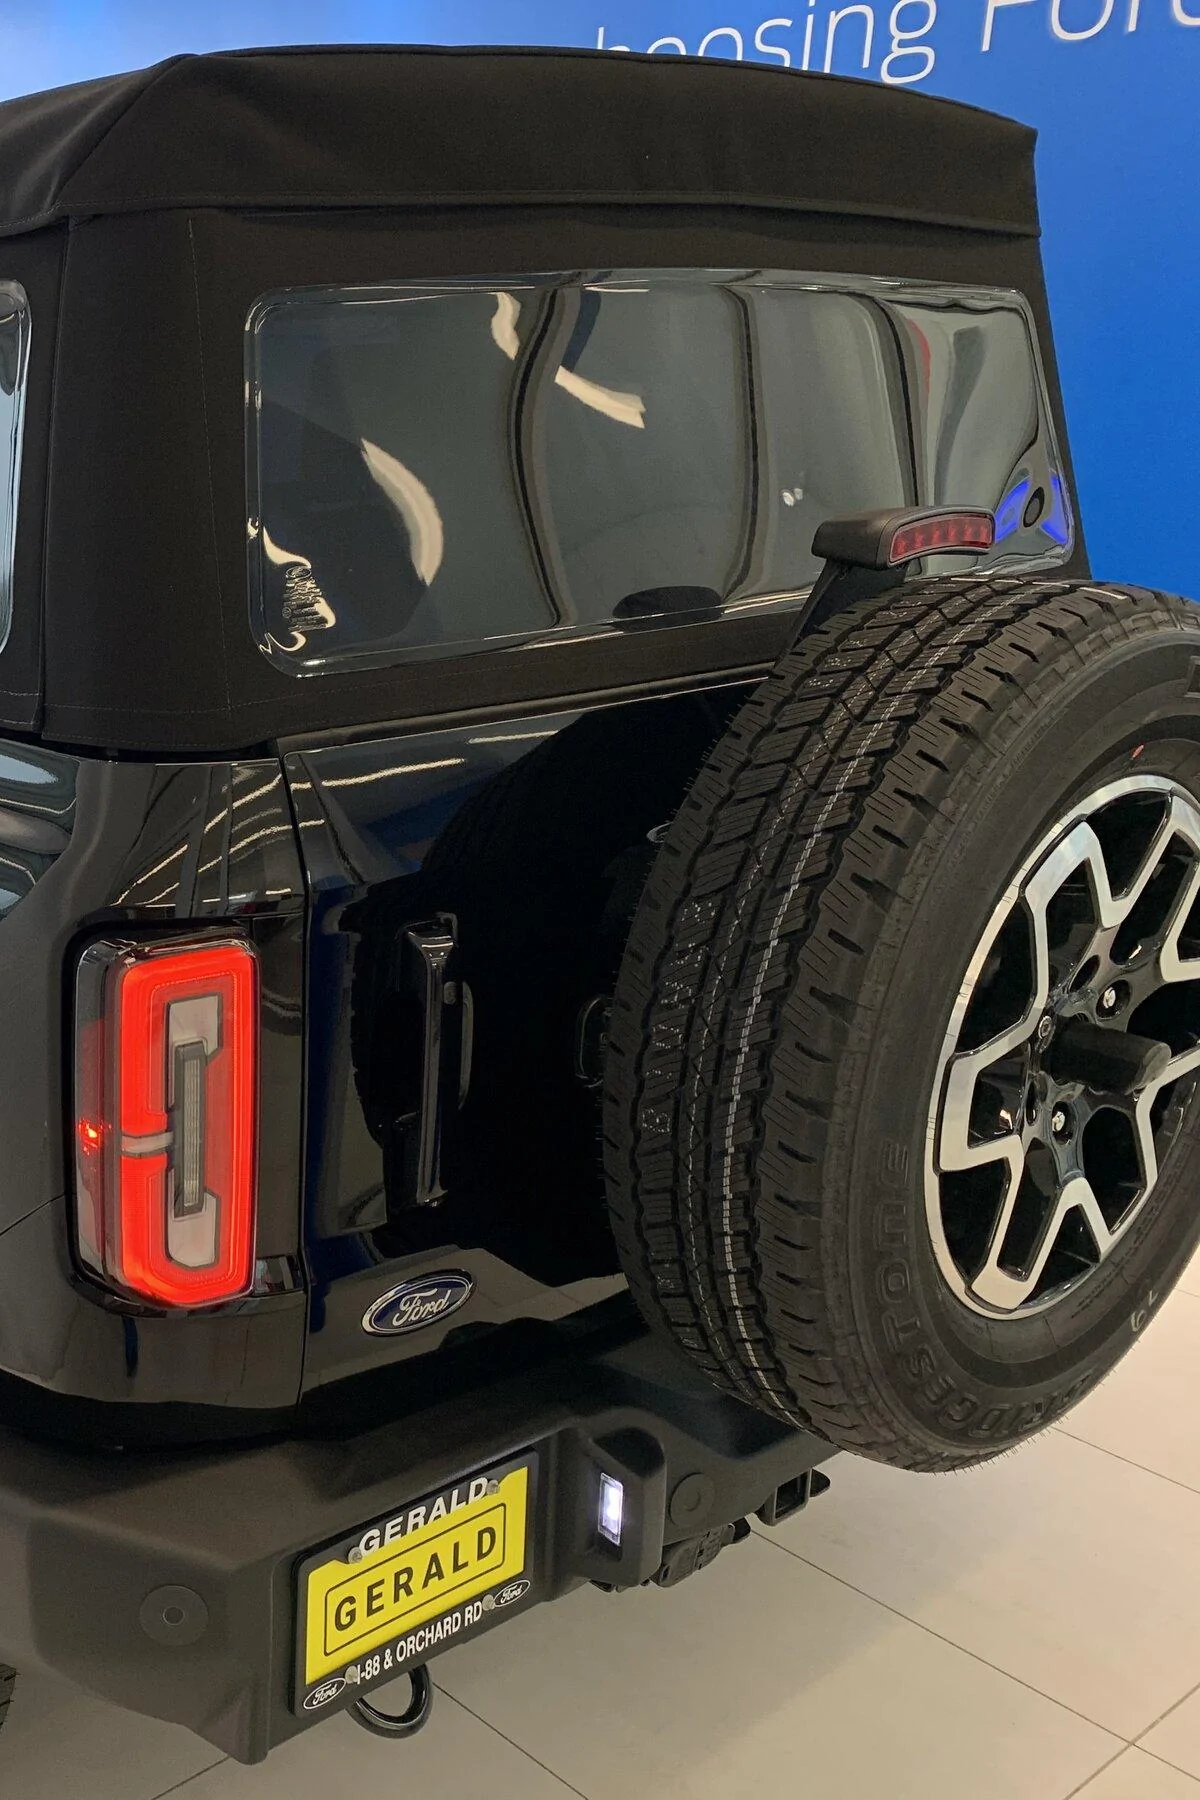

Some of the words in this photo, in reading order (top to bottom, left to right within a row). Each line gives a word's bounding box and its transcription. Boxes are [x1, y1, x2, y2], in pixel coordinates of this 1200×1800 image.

[392, 1287, 452, 1327] Ford
[359, 1476, 489, 1557] GERALD
[334, 1525, 497, 1632] GERALD
[356, 1654, 380, 1685] I-88
[383, 1648, 393, 1670] &
[395, 1611, 462, 1662] ORCHARD
[464, 1600, 483, 1627] RD
